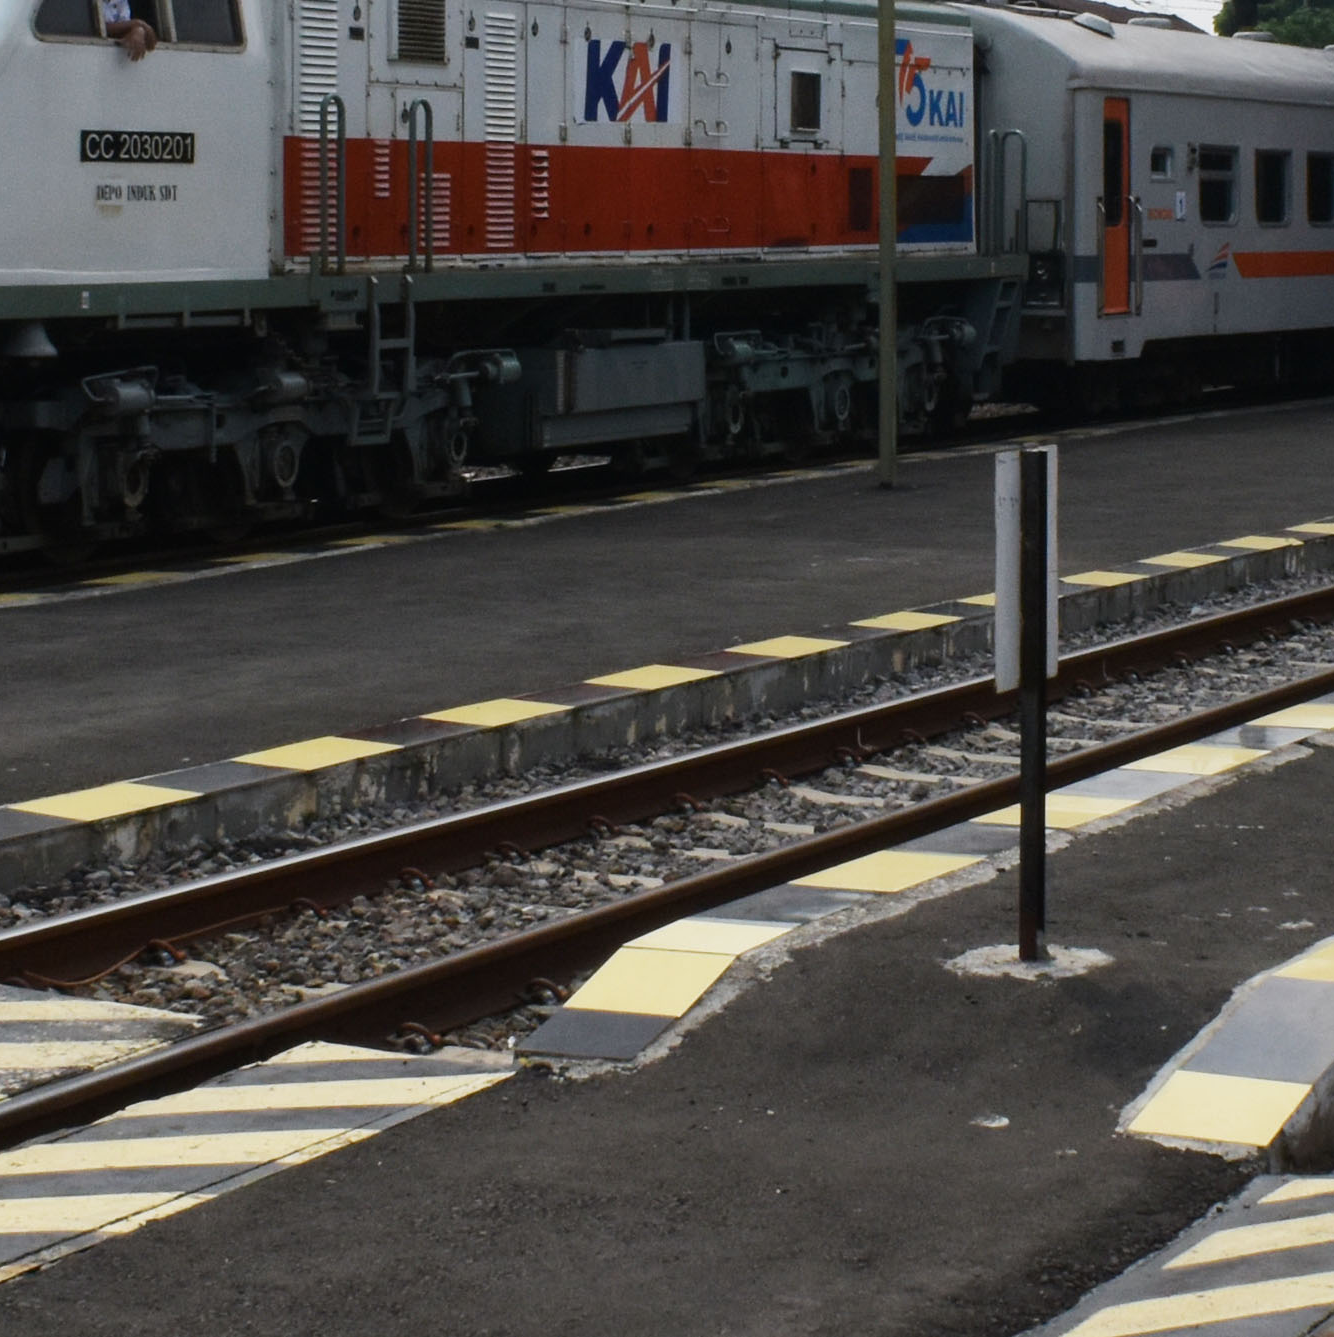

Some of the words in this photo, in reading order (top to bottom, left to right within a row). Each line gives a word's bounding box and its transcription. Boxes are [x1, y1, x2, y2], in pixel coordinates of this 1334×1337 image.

[584, 39, 671, 123] KAI
[929, 89, 964, 128] KAI
[86, 133, 115, 159] CC
[119, 134, 193, 160] 2030201
[97, 185, 123, 201] DEPO
